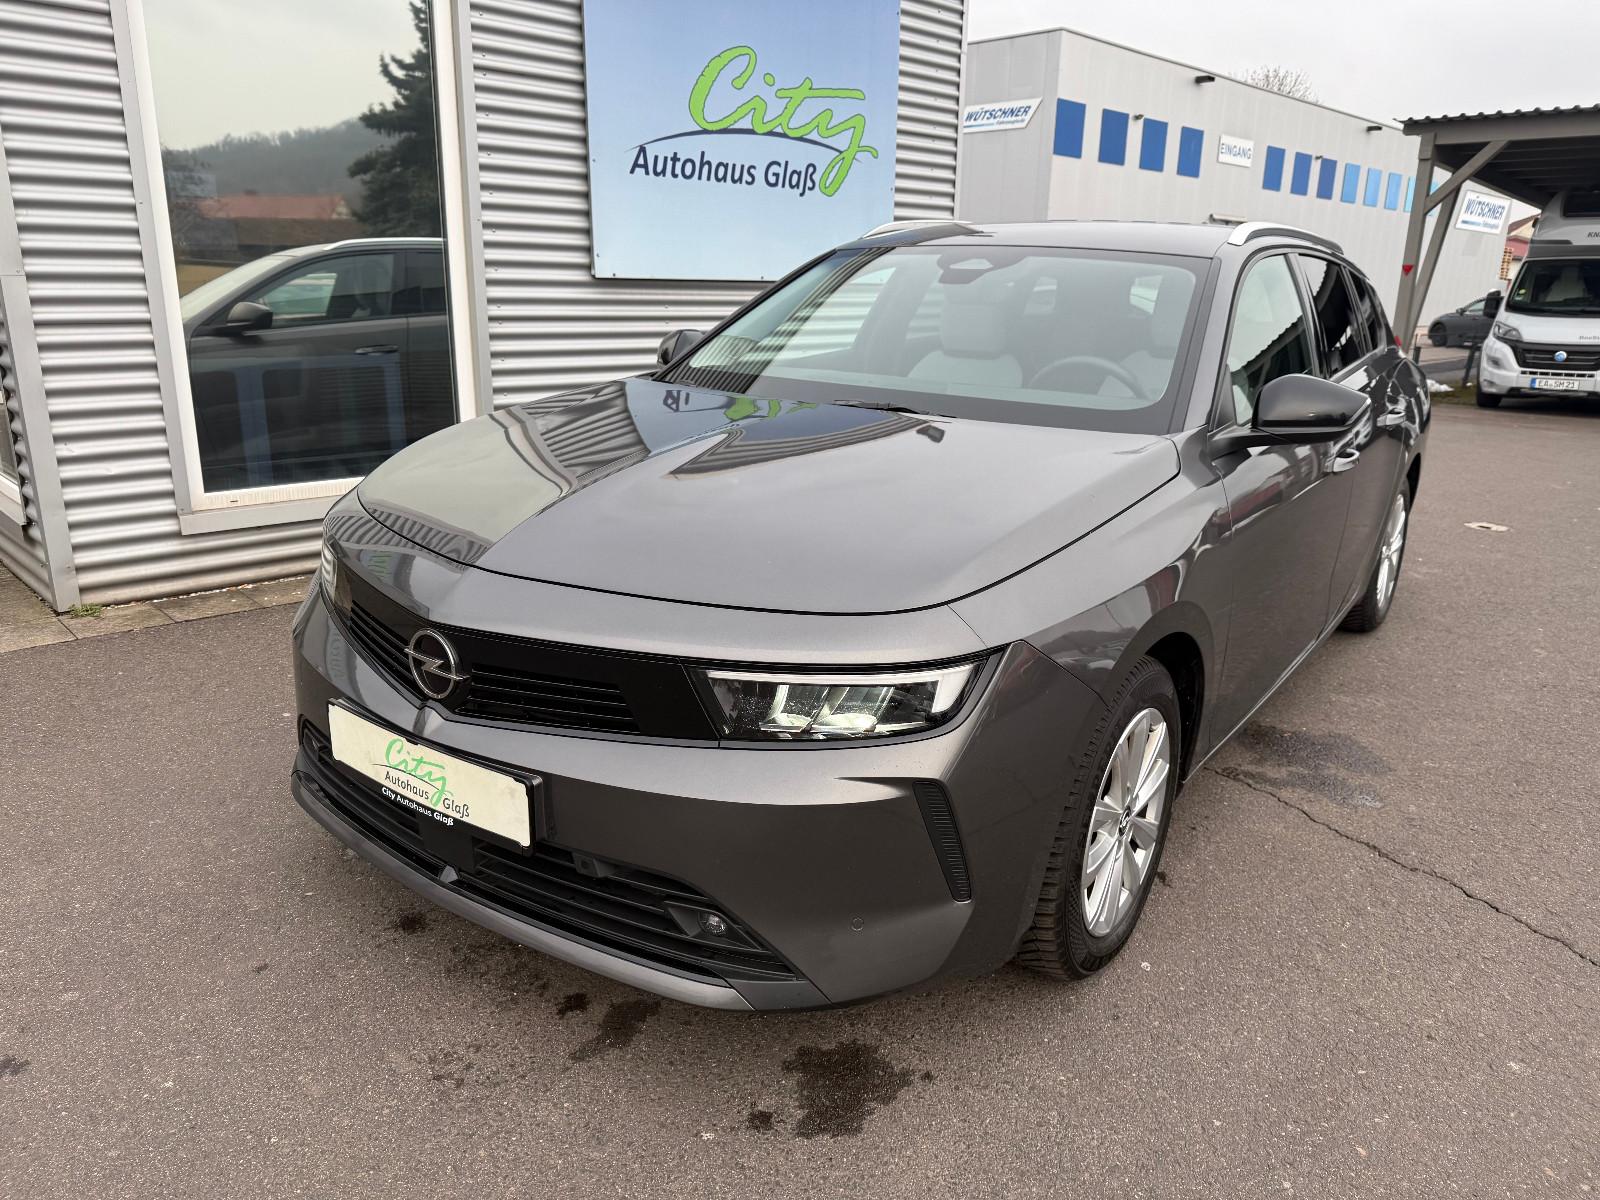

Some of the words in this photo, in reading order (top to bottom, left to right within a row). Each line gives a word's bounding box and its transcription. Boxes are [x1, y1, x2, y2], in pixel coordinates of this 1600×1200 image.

[688, 45, 879, 198] City
[965, 106, 1032, 122] WÜTSCHNER
[629, 145, 757, 186] Autohaus
[764, 160, 817, 198] Glaß
[1220, 142, 1252, 160] EINGANG
[385, 738, 454, 808] City
[385, 771, 430, 800] Autohaus
[443, 798, 470, 818] Glaß
[382, 787, 396, 800] City
[396, 795, 433, 817] Autohaus
[433, 812, 454, 826] Glaß
